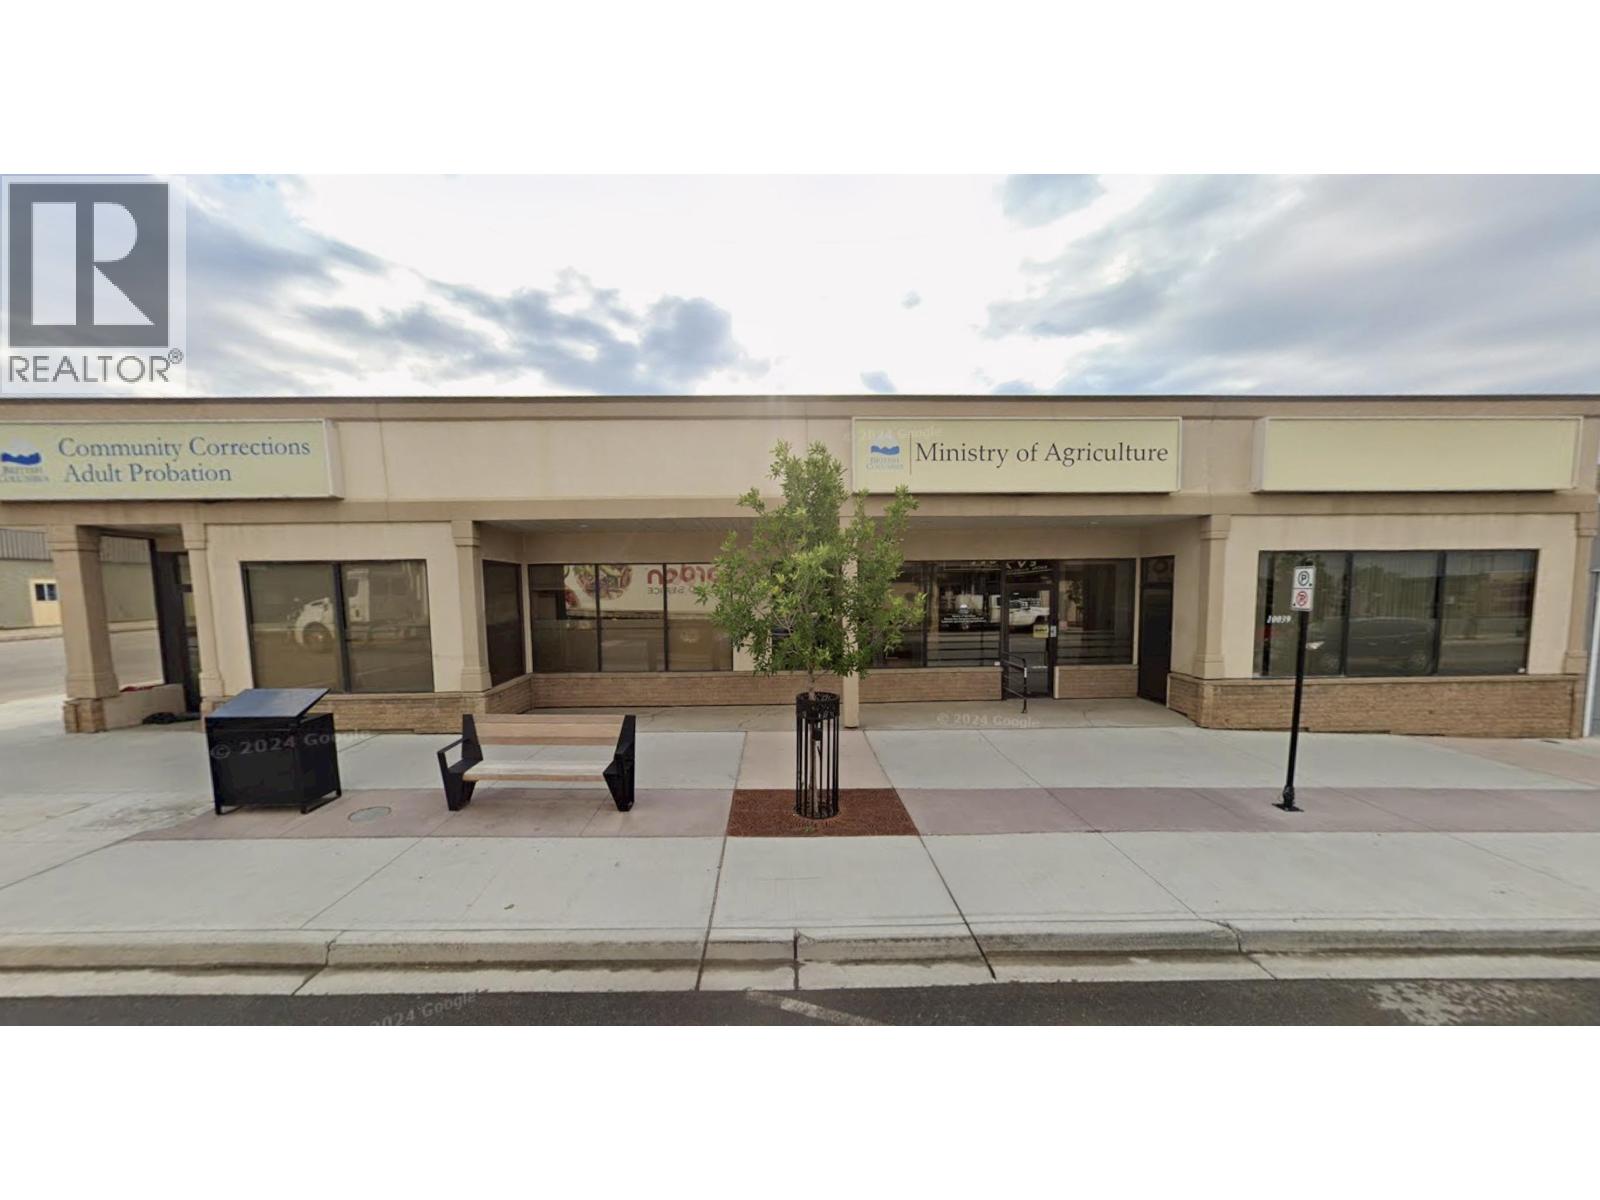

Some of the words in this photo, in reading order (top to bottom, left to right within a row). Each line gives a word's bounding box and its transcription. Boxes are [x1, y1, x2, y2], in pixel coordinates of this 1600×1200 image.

[58, 436, 182, 463] Community
[189, 436, 311, 456] Corrections
[916, 442, 1008, 468] Ministry
[1016, 442, 1039, 462] of
[1045, 442, 1169, 467] Agriculture
[63, 463, 122, 483] Adult
[130, 462, 232, 483] Probation
